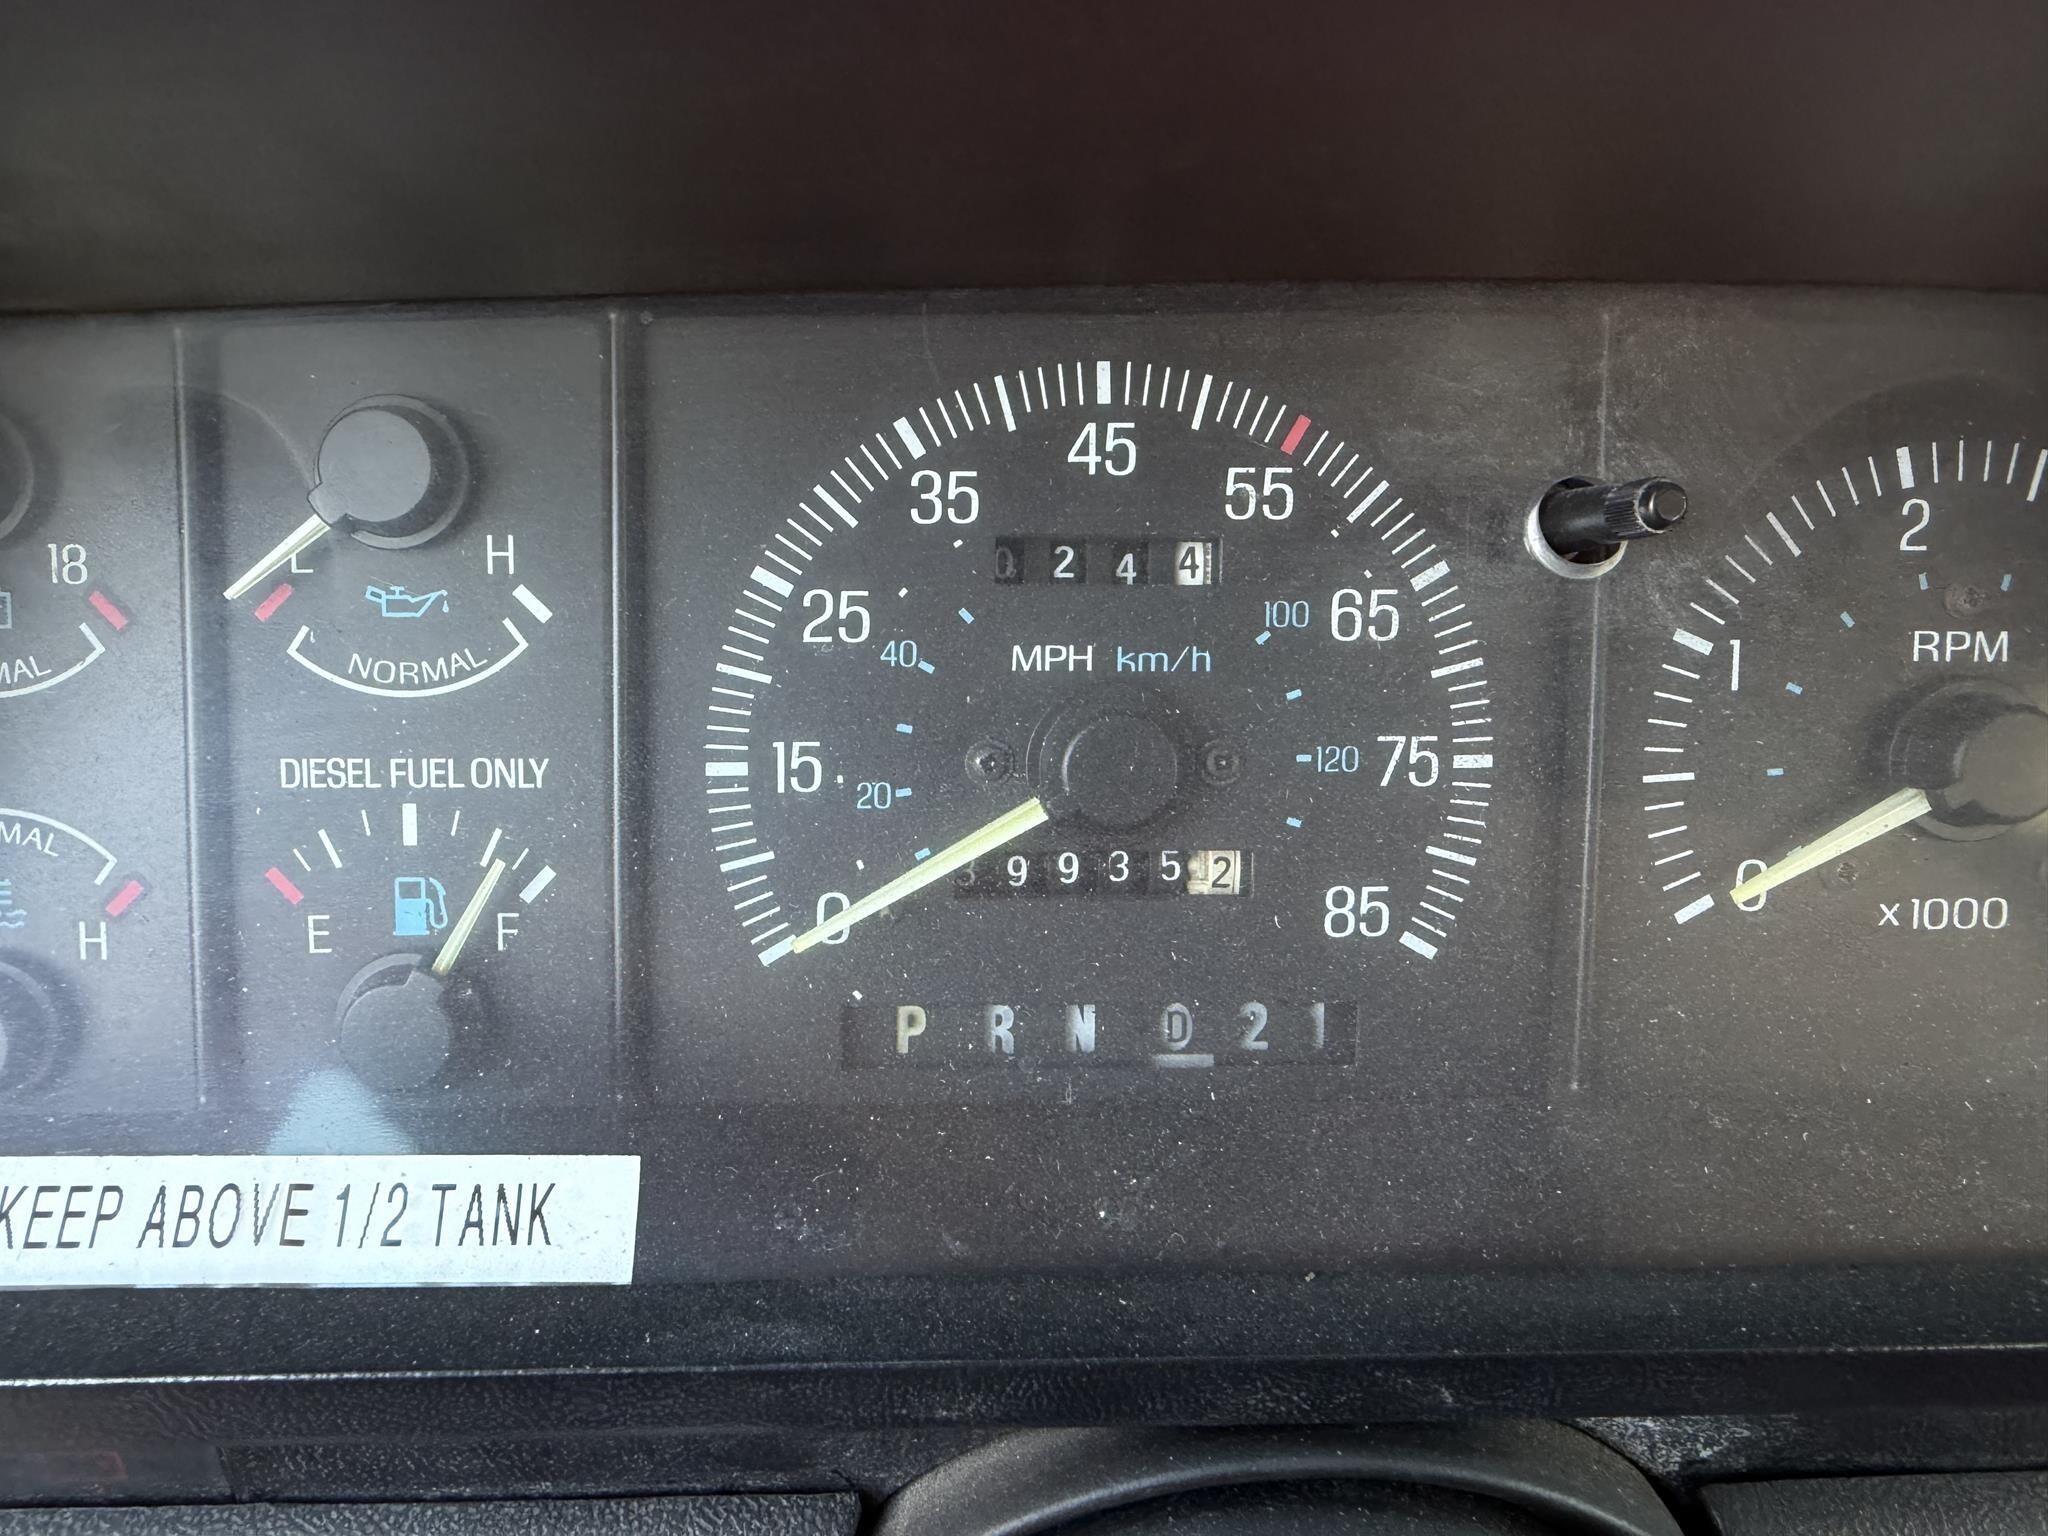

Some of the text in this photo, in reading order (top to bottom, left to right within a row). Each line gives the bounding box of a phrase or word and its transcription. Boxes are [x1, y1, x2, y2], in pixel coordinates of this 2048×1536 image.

[1068, 423, 1136, 475] 45
[910, 470, 979, 524] 35
[1225, 467, 1294, 520] 55
[1900, 499, 1930, 550] 2
[48, 543, 88, 584] 18
[487, 535, 514, 574] H
[803, 589, 870, 643] 25
[1265, 601, 1309, 628] 100
[1331, 589, 1399, 641] 65
[348, 648, 488, 685] NORMAL
[880, 640, 917, 667] 40
[1011, 645, 1211, 672] MPH km/h
[1730, 639, 1740, 690] 1
[1913, 631, 2008, 662] RPM
[280, 758, 549, 788] DIESEL FUEL ONLY
[773, 741, 821, 793] 15
[1316, 746, 1359, 772] 120
[1377, 735, 1439, 787] 75
[857, 782, 892, 809] 20
[1736, 859, 1768, 912] 0
[308, 914, 332, 953] E
[498, 912, 520, 951] F
[816, 892, 851, 945] 0
[1324, 886, 1389, 937] 85
[79, 921, 108, 960] H
[897, 1005, 926, 1054] P
[987, 1004, 1015, 1053] R
[1065, 1004, 1096, 1053] N
[1239, 1002, 1269, 1050] 2
[0, 1183, 555, 1249] KEEP ABOVE 1/2 TANK
